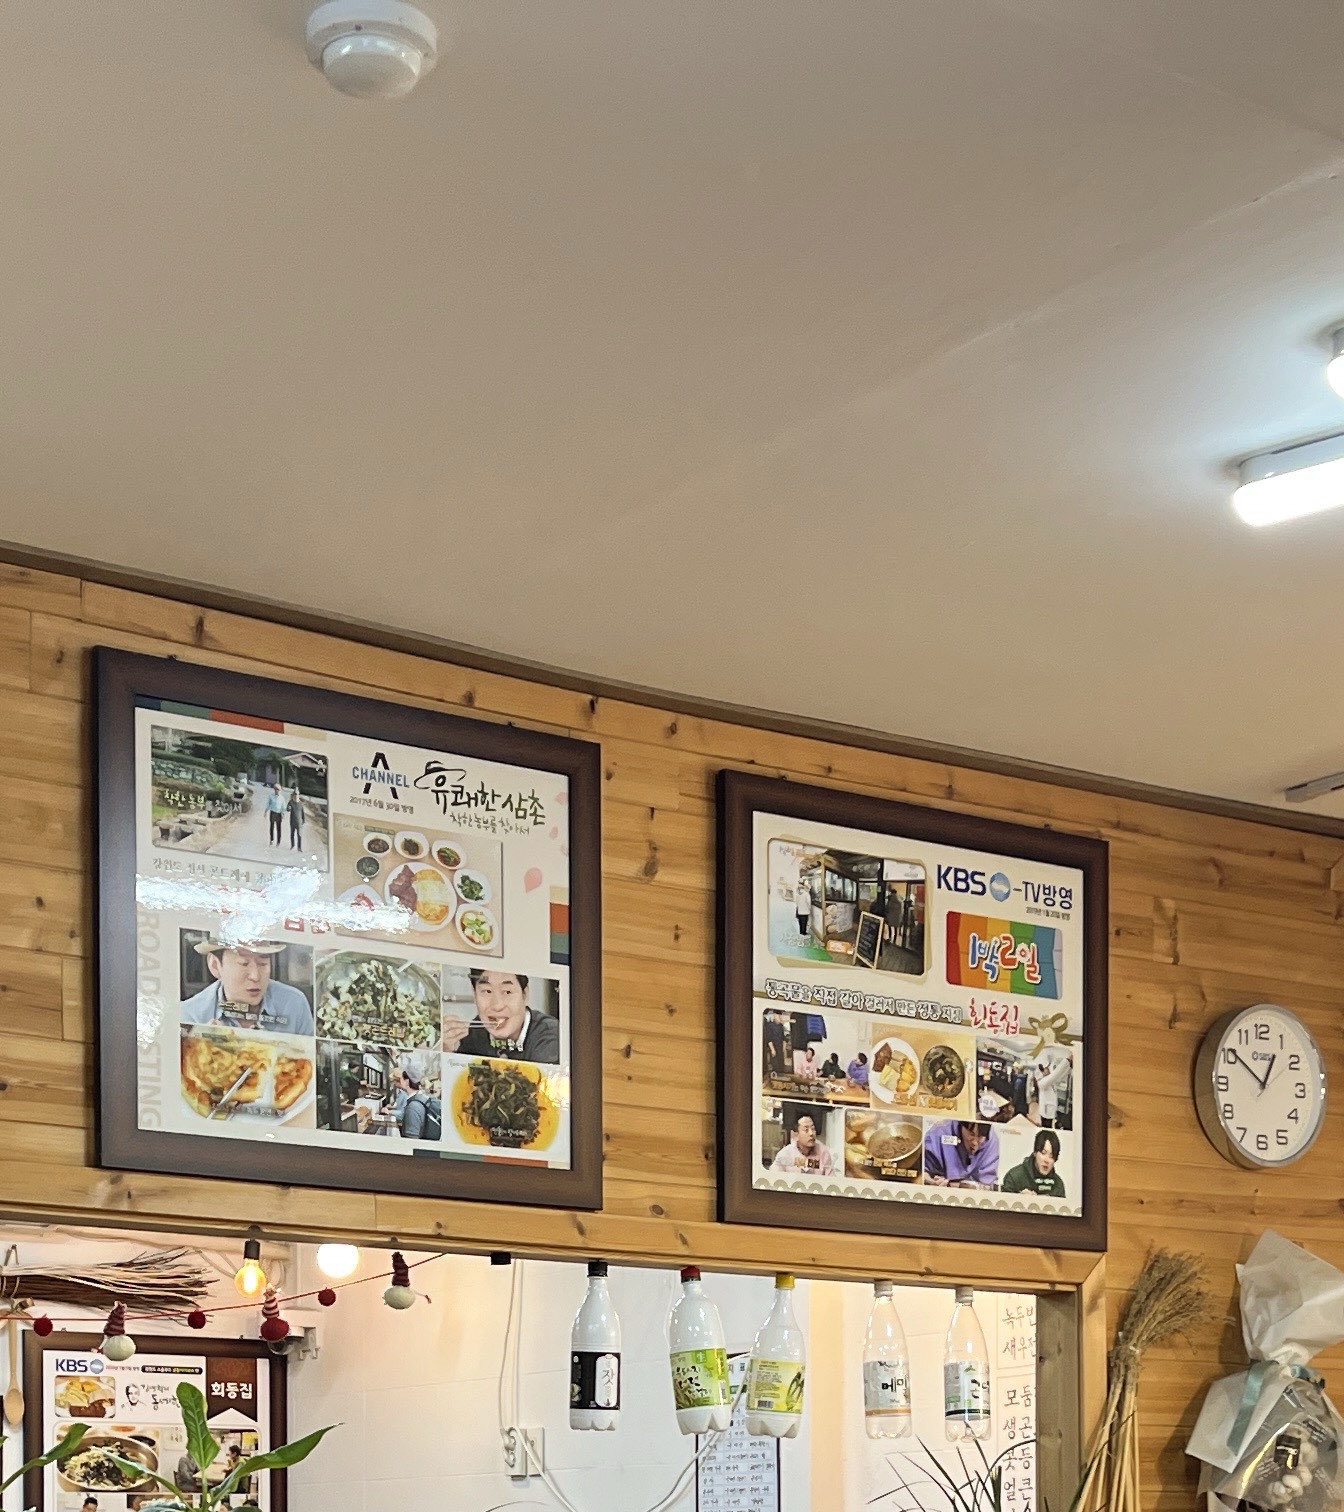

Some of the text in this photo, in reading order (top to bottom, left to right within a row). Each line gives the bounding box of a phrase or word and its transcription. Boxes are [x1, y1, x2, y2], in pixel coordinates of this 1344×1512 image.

[352, 765, 410, 789] CHANNEL
[430, 774, 546, 826] 유쾌한 삼촌
[937, 864, 987, 897] KBS
[969, 932, 1042, 984] 1박2일
[969, 997, 1021, 1036] 회동집
[1238, 1028, 1250, 1046] 11
[1254, 1023, 1270, 1041] 12
[1278, 1034, 1284, 1050] 1
[1221, 1047, 1238, 1065] 10
[1288, 1054, 1301, 1071] 2
[1217, 1075, 1229, 1092] 9
[1294, 1082, 1307, 1099] 3
[1223, 1103, 1234, 1120] 8
[1287, 1107, 1300, 1124] 4
[1236, 1126, 1248, 1144] 7
[1255, 1133, 1269, 1151] 6
[1275, 1129, 1289, 1146] 5
[55, 1358, 88, 1373] KBS
[210, 1381, 253, 1400] 회동집
[1005, 1388, 1036, 1407] 모둠
[1003, 1417, 1036, 1441] 생곤
[1003, 1477, 1034, 1501] 얼큰
